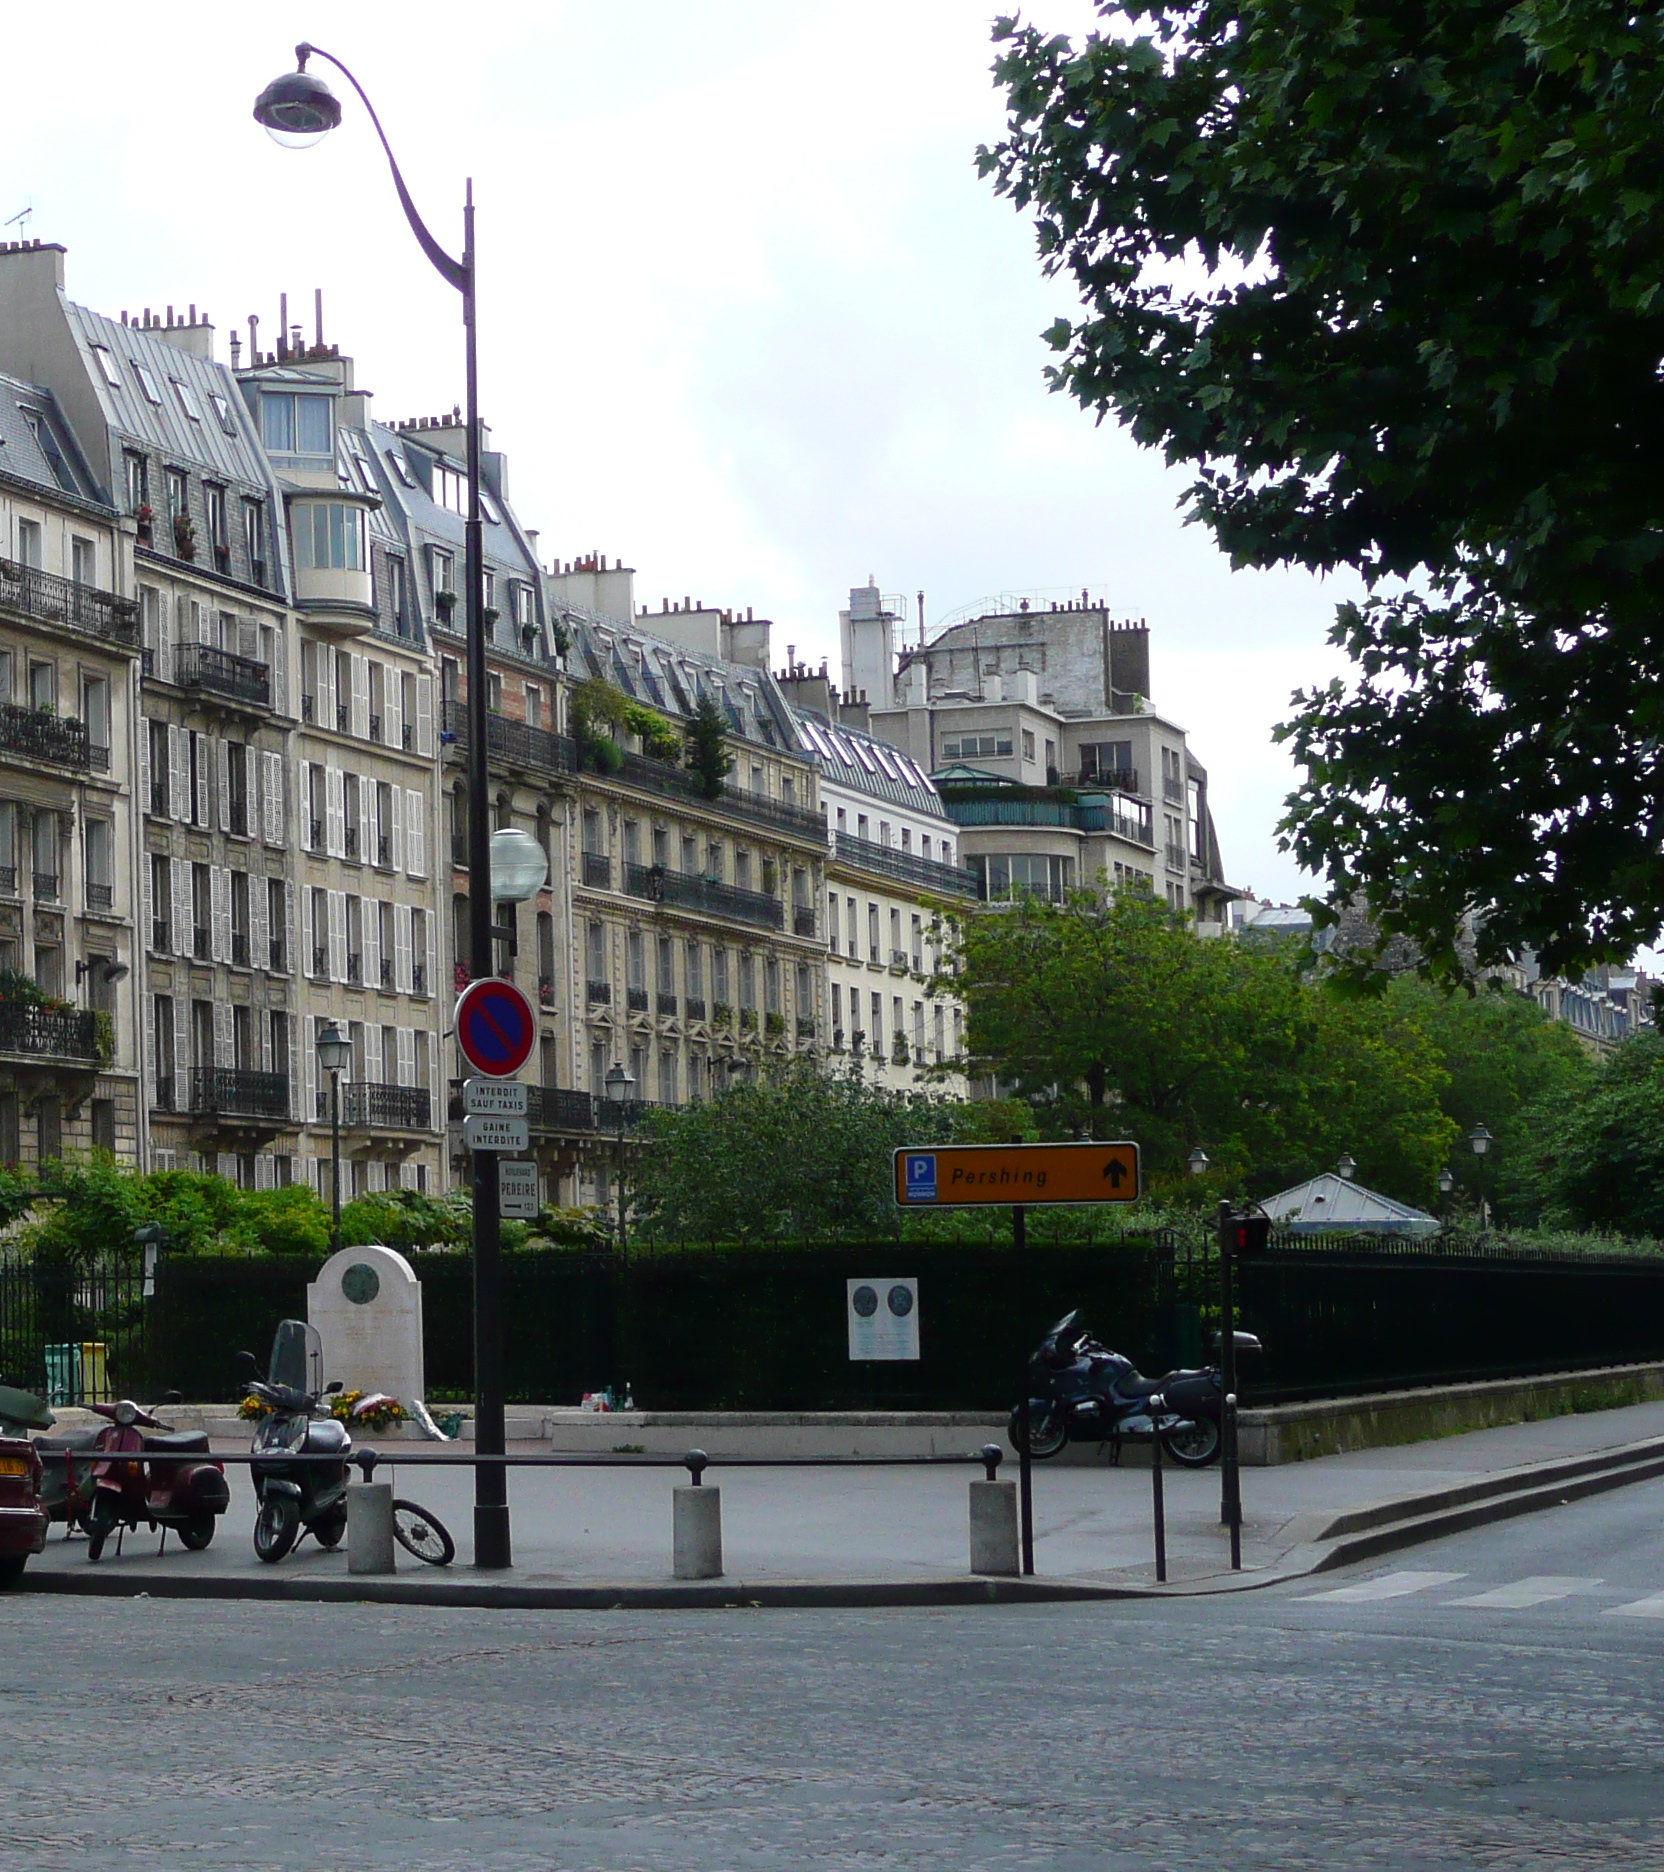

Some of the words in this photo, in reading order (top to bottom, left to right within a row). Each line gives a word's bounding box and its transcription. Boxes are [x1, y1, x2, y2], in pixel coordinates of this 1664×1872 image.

[476, 1087, 518, 1097] INTERDIT
[471, 1099, 494, 1109] SAUF
[498, 1100, 523, 1110] TAXIS
[483, 1122, 511, 1132] GAINE
[472, 1135, 521, 1145] INTERDITE
[914, 1161, 927, 1179] P
[952, 1167, 1047, 1187] Pershing
[501, 1182, 536, 1197] PEREIRE
